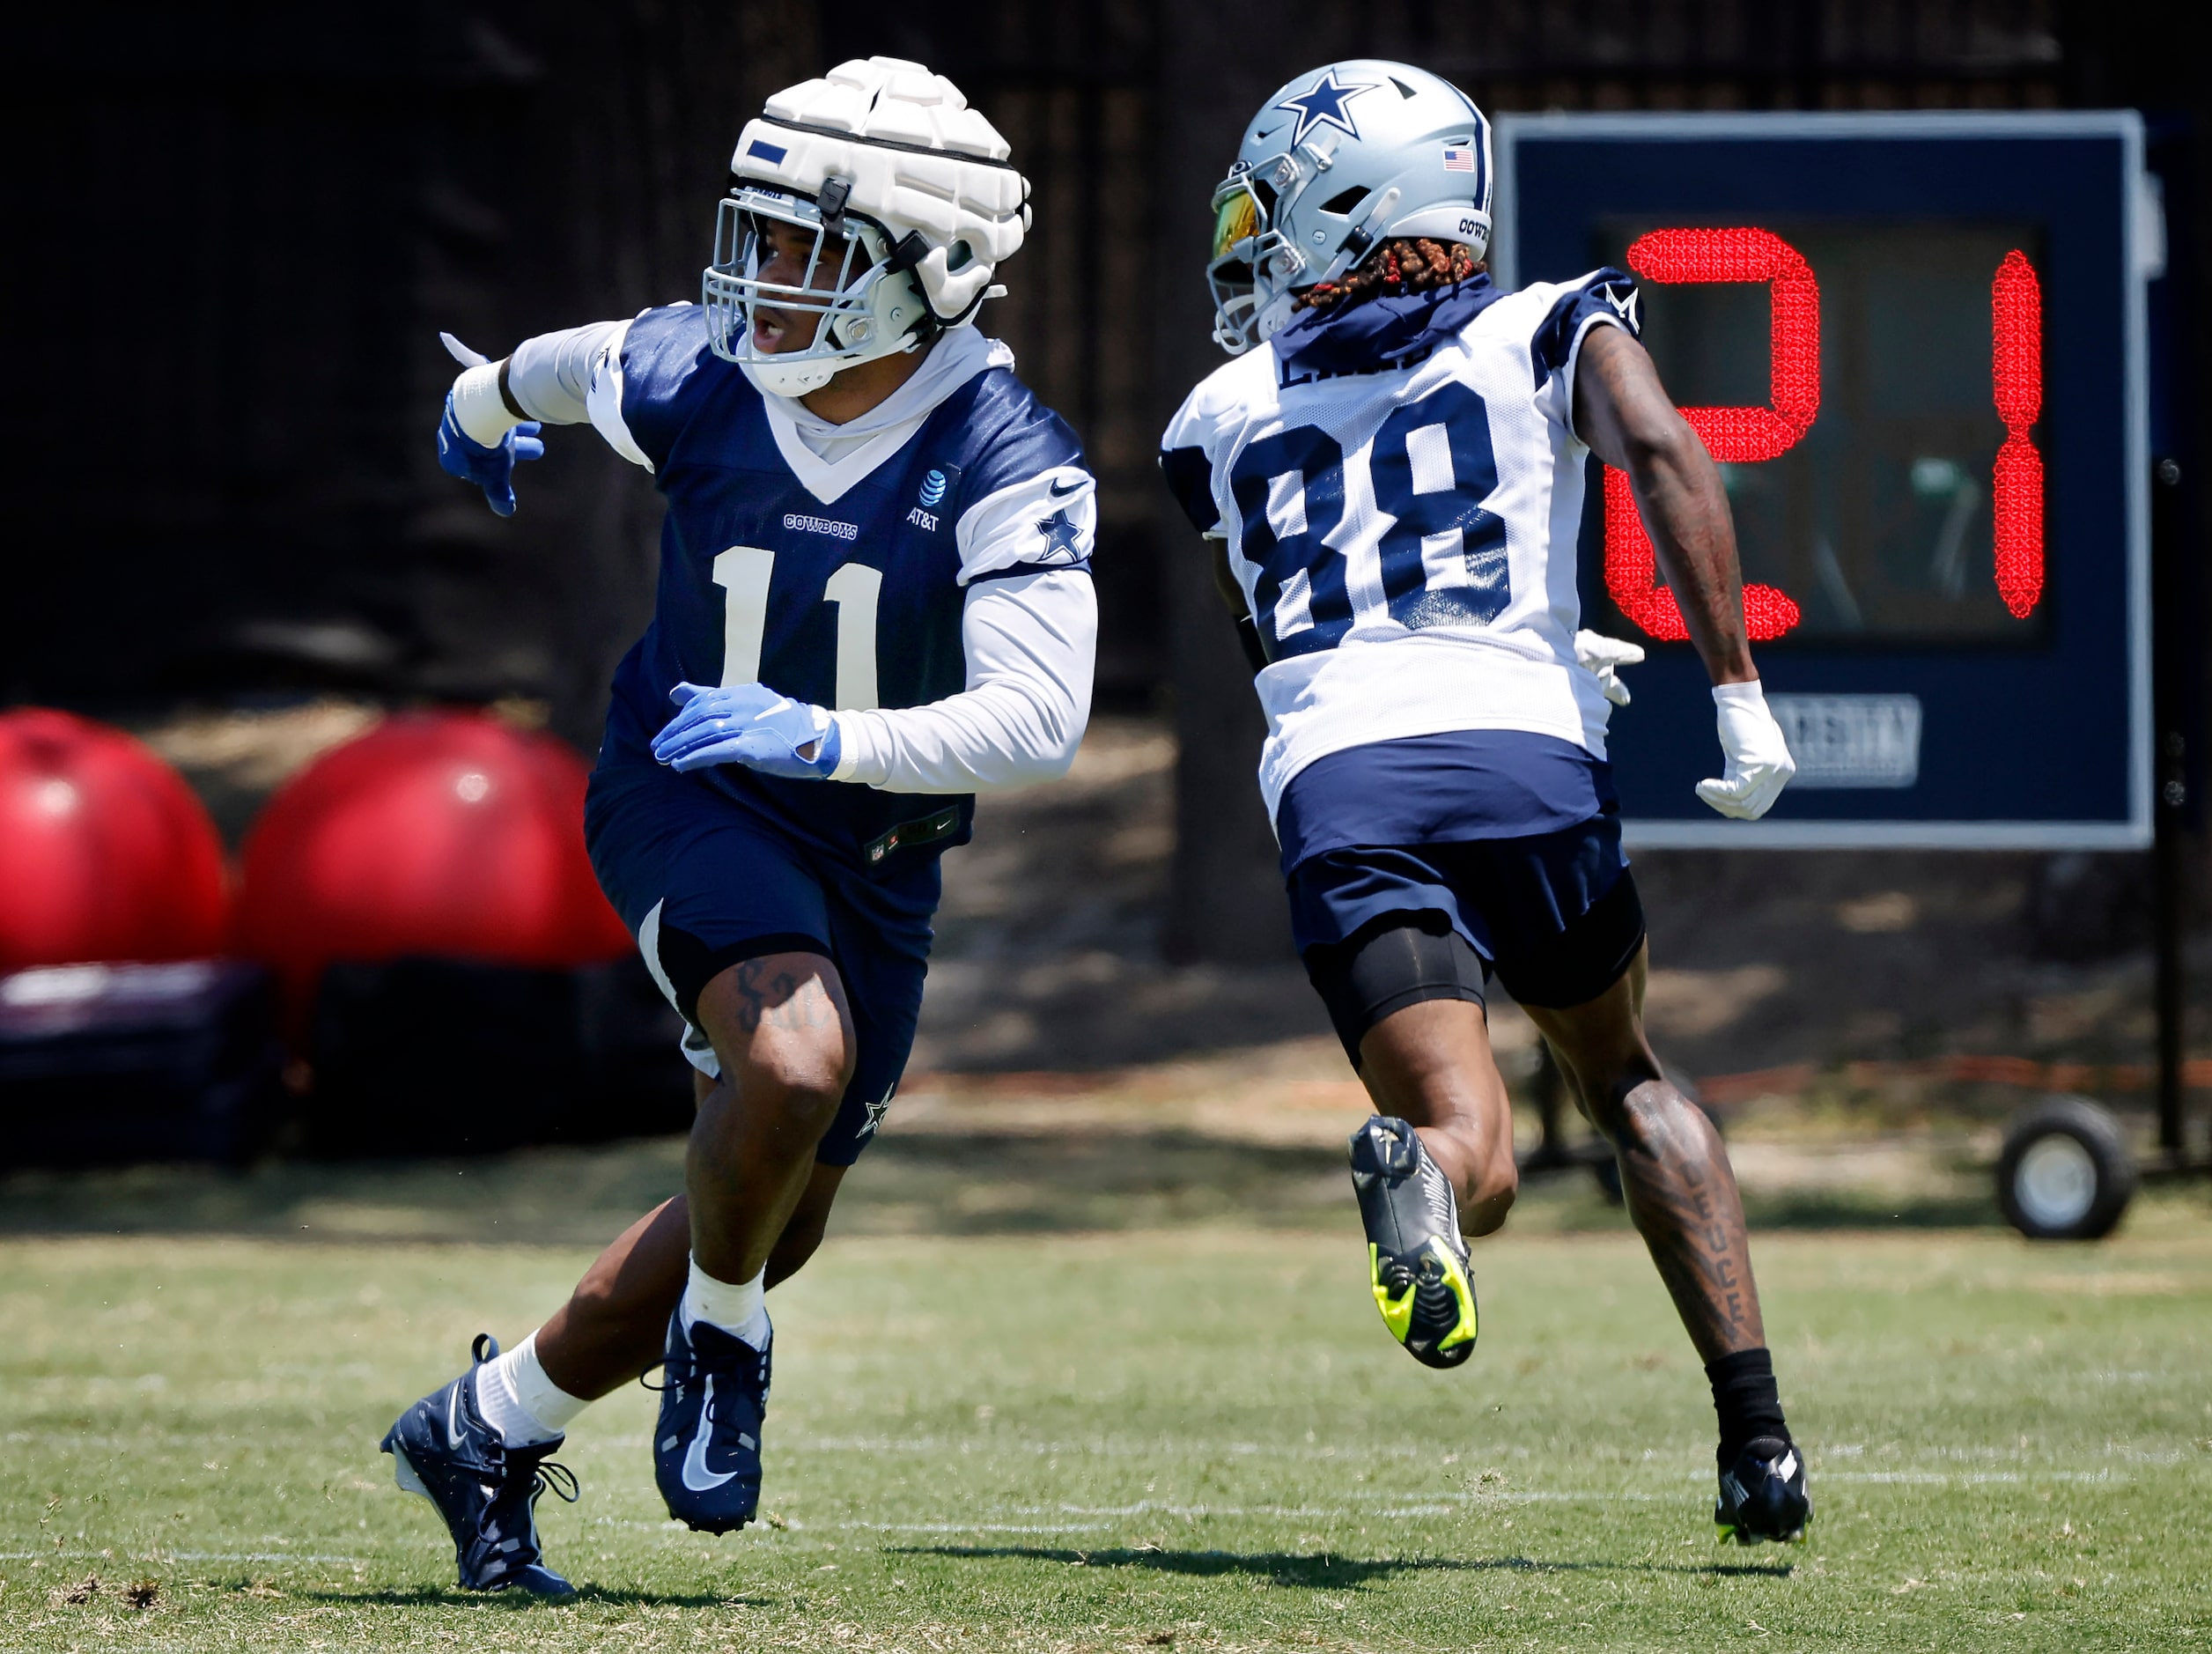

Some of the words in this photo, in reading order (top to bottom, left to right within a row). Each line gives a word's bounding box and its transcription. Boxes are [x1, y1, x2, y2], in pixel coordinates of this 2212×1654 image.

[1604, 228, 2045, 642] 21
[784, 513, 858, 540] COWBOYS
[906, 507, 939, 532] AT&T
[1229, 380, 1510, 661] 88
[712, 545, 882, 710] 11
